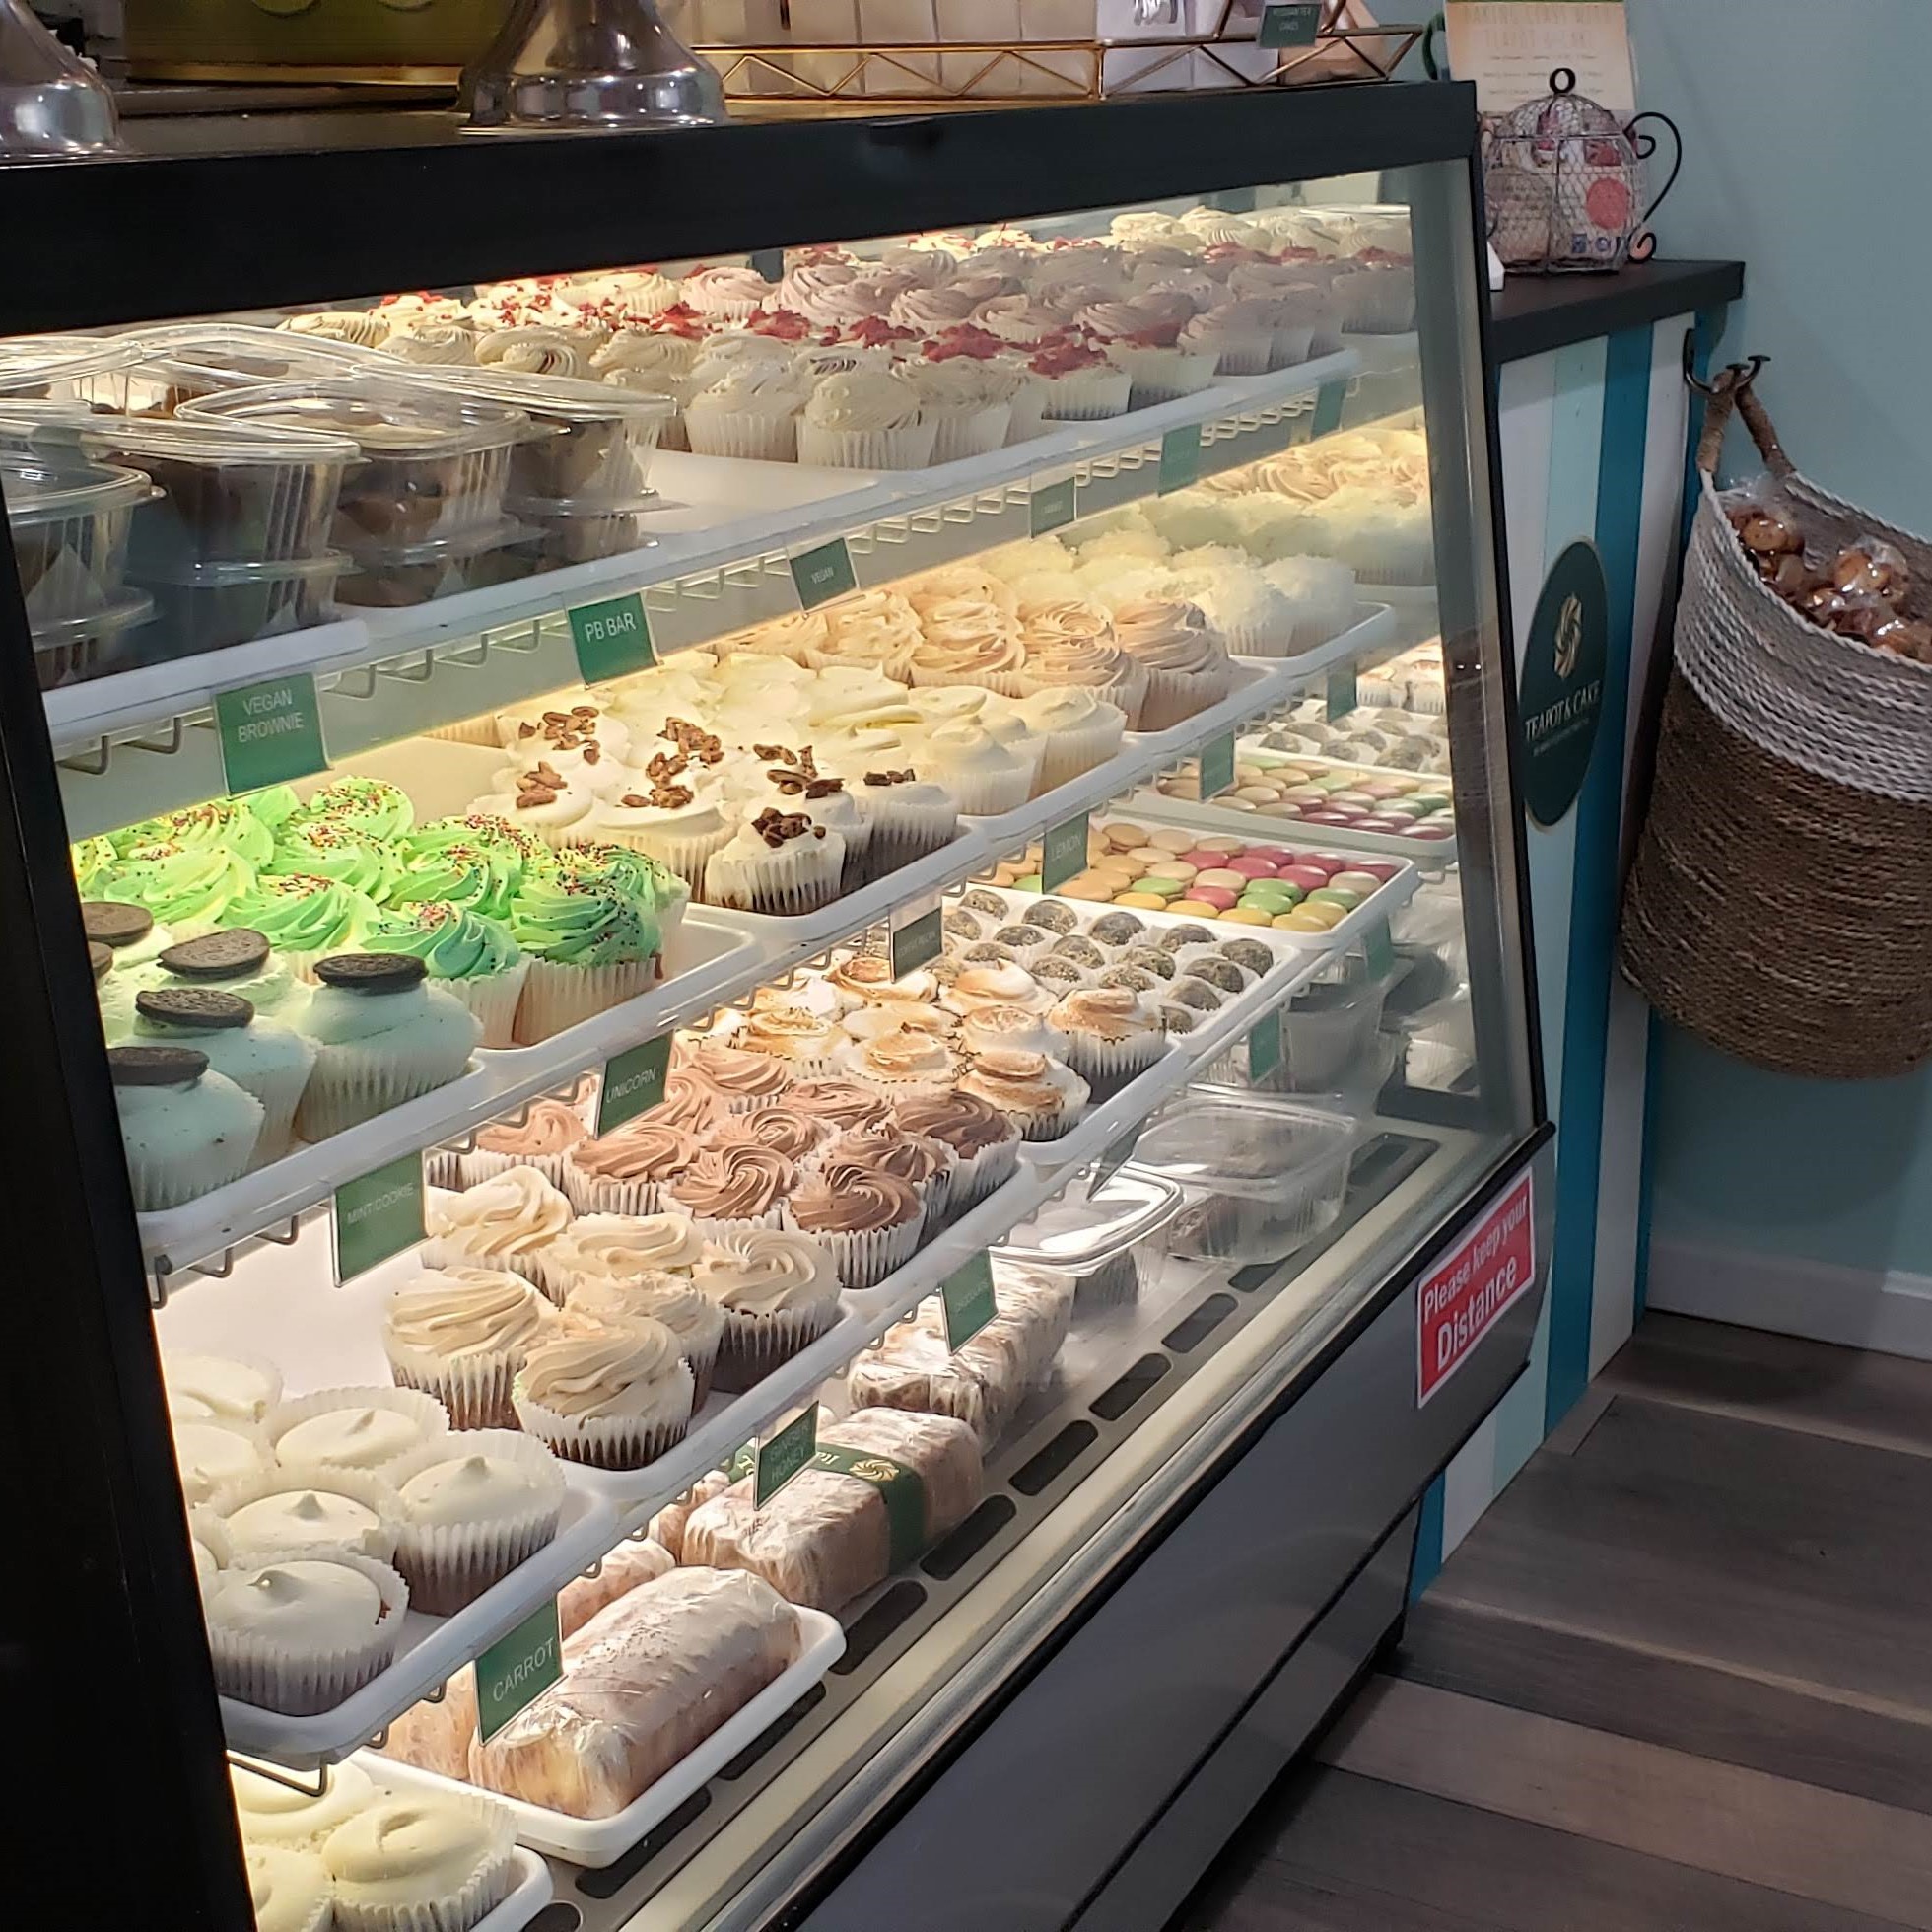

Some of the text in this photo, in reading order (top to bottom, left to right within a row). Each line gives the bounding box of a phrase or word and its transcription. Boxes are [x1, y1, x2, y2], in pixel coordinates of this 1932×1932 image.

[585, 612, 637, 643] PB BAR
[242, 689, 293, 716] VEGAN
[238, 712, 305, 743] BROWNIE
[1525, 699, 1565, 741] TEAPOT
[1051, 833, 1082, 862] LEMON
[606, 1067, 656, 1103] UNICORN
[347, 1202, 373, 1225] MINT
[1424, 1194, 1528, 1324] Please keep your
[1437, 1255, 1518, 1372] Distance
[493, 1636, 555, 1702] CARROT
